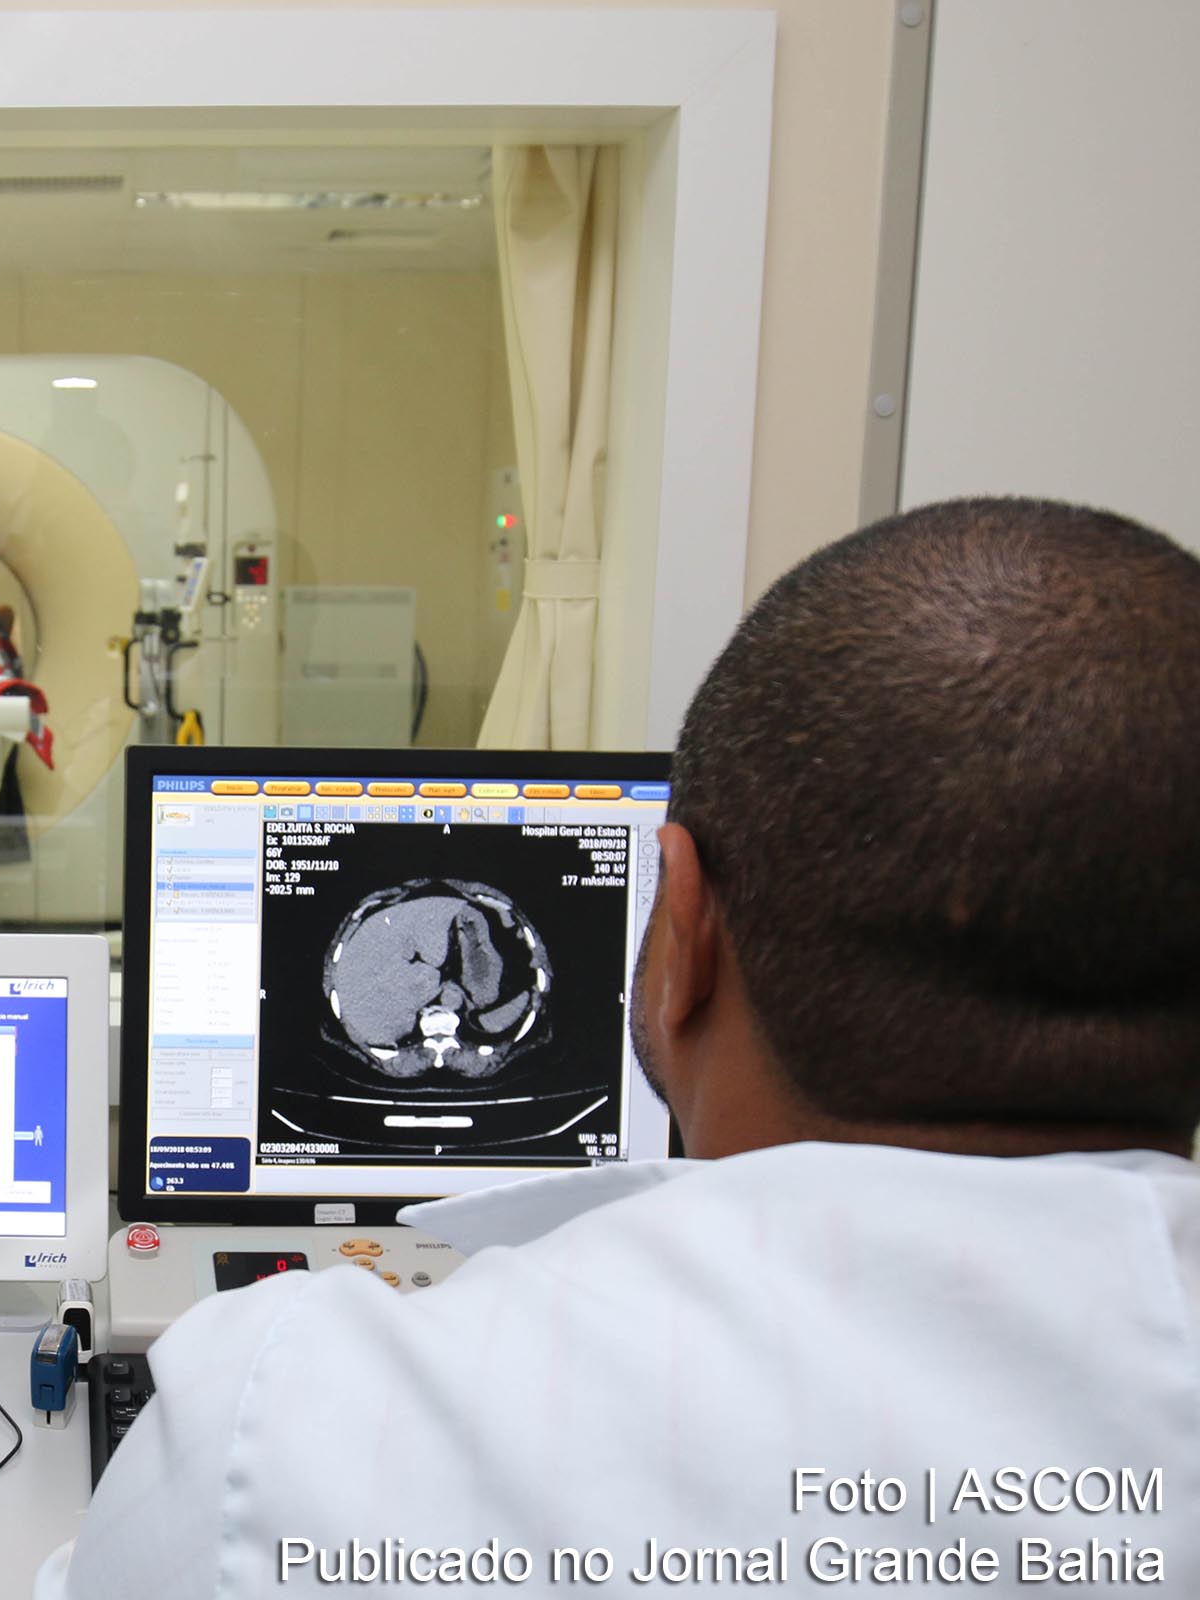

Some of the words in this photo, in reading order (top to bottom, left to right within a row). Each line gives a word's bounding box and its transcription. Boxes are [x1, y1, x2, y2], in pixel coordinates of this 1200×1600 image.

[157, 780, 206, 791] PHILIPS
[266, 823, 313, 833] EDELZUITA
[314, 823, 323, 834] S.
[324, 823, 356, 834] ROCHA
[443, 823, 451, 835] A
[522, 825, 558, 838] Hospital
[559, 826, 582, 837] Geral
[583, 826, 596, 837] do
[597, 826, 628, 838] Estado
[282, 835, 331, 846] 10115526/F
[578, 838, 627, 850] 2018/09/18
[591, 851, 627, 862] 08:50:07
[266, 860, 288, 871] DOB:
[290, 860, 340, 871] 1951/11/10
[594, 864, 611, 874] 140
[613, 864, 626, 875] kV
[266, 872, 281, 883] Im:
[284, 872, 301, 883] 129
[562, 875, 578, 886] 177
[581, 875, 626, 887] mAs/slice
[265, 885, 293, 895] -202.5
[295, 885, 315, 896] mm
[9, 980, 55, 995] ulrich
[259, 988, 267, 999] R
[601, 1134, 617, 1144] 260
[434, 1145, 442, 1156] P
[604, 1146, 617, 1156] 60
[25, 1253, 67, 1267] ulrich
